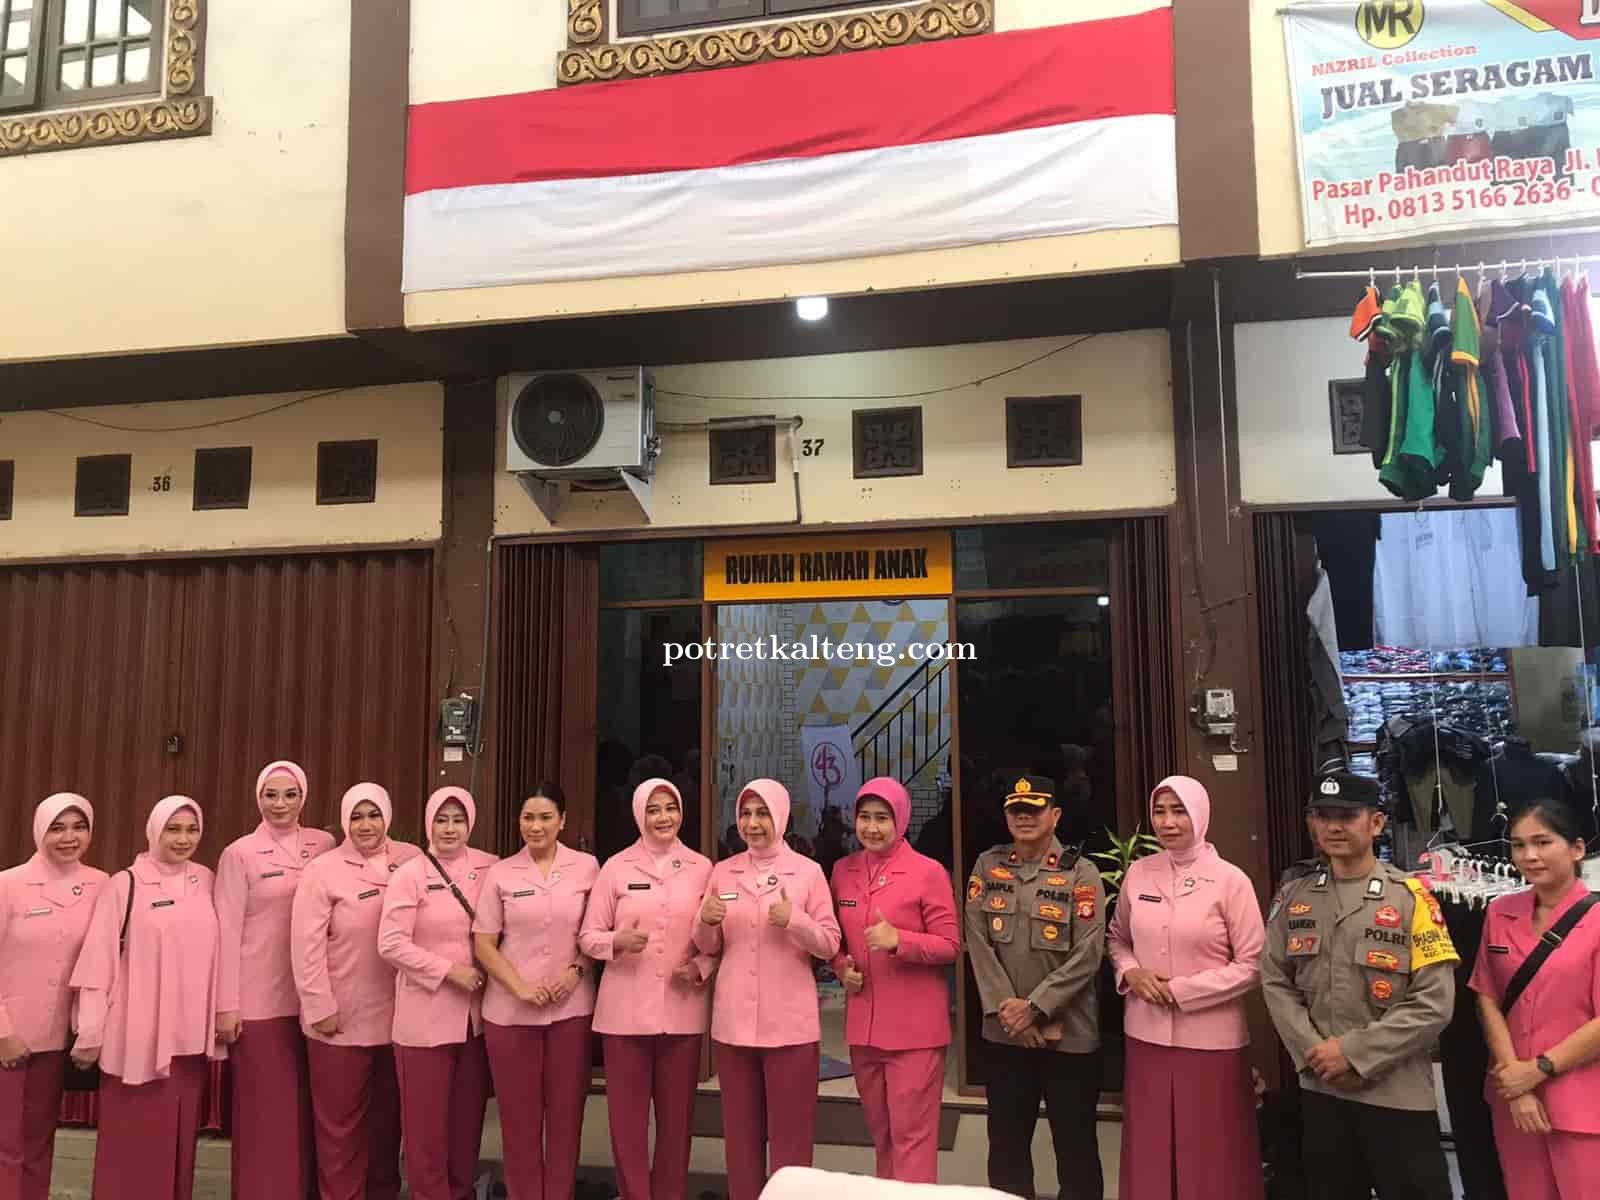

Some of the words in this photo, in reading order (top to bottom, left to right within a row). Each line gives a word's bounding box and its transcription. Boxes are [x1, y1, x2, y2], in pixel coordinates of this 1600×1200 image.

[1311, 55, 1377, 77] NAZRIL
[1382, 45, 1477, 66] Collection
[1321, 78, 1403, 119] JUAL
[1411, 54, 1592, 99] SERAGAM
[1312, 178, 1373, 200] Pasar
[1379, 160, 1491, 192] Pahandut
[1497, 158, 1553, 181] Raya
[1564, 149, 1591, 172] Jl.
[1344, 203, 1383, 228] Hp.
[1388, 191, 1445, 219] 0813
[1452, 186, 1507, 211] 5166
[1513, 180, 1571, 206] 2636
[801, 439, 824, 457] 37
[152, 476, 171, 492] 36
[725, 552, 795, 585] RUMAH
[799, 549, 870, 583] RAMAH
[874, 547, 929, 580] ANAK
[1036, 888, 1070, 902] POLRI
[1364, 927, 1408, 946] POLRI
